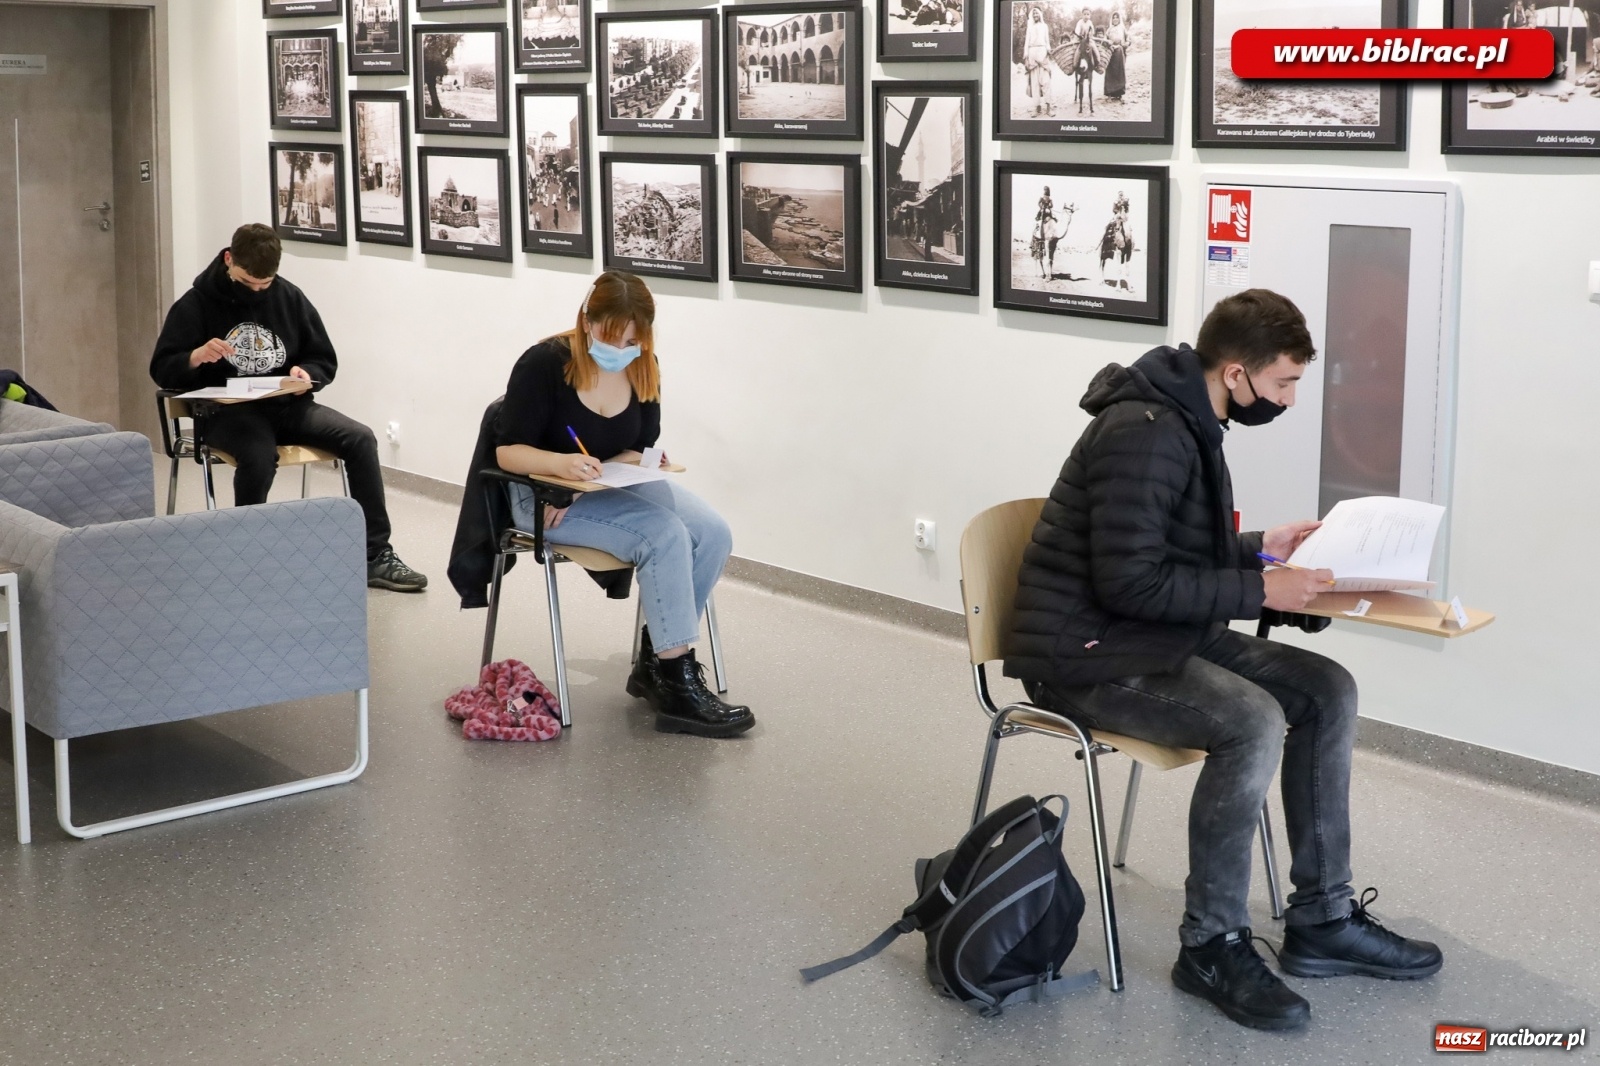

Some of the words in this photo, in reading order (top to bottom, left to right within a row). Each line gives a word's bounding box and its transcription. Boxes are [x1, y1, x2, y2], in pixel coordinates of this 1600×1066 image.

[1253, 129, 1278, 137] Jeziorem
[1308, 130, 1316, 138] (w
[1345, 130, 1375, 139] Tyberiady)
[1536, 135, 1558, 143] Arabki
